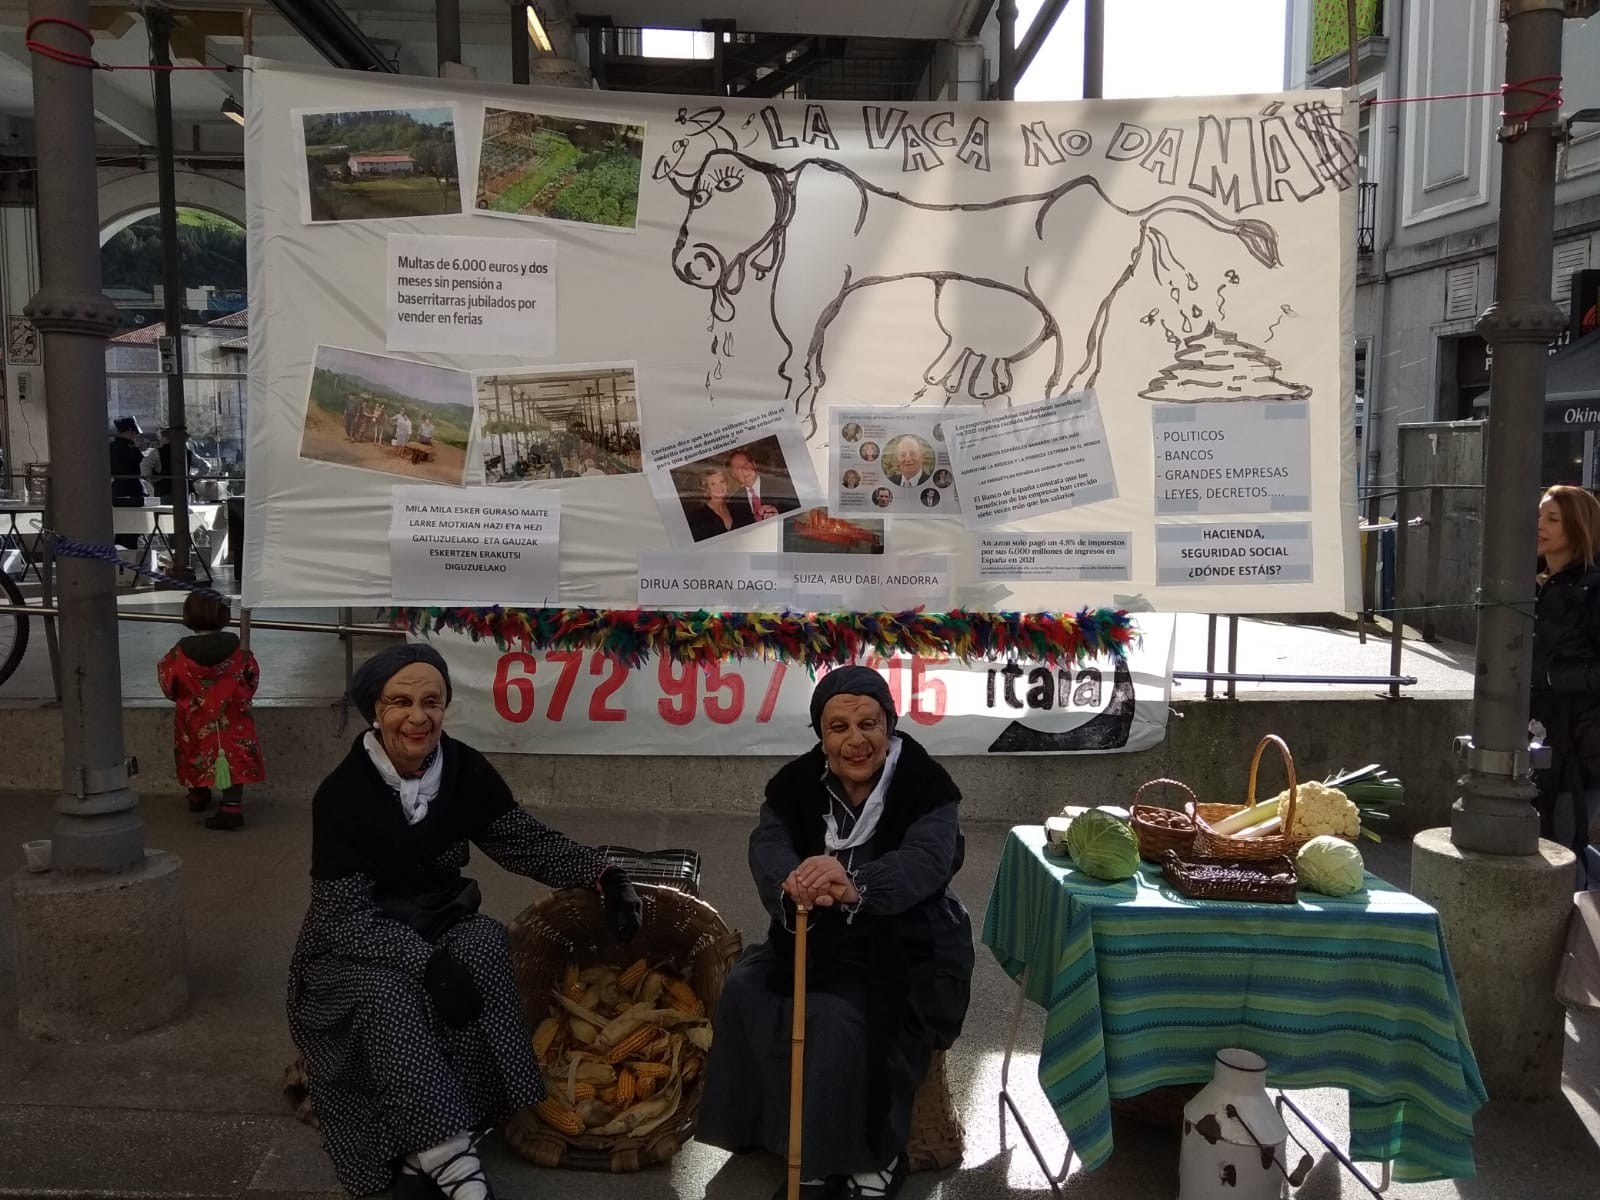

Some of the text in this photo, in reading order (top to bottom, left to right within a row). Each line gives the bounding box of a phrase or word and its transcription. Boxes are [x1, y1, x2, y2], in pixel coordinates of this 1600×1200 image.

[760, 104, 840, 150] LA
[862, 105, 991, 172] VACA
[1105, 122, 1184, 185] DA
[398, 256, 548, 276] Multas de 6.000 euros y dos
[398, 276, 502, 291] meses sin pensión a
[398, 292, 536, 311] baserritarras jubilados por
[398, 311, 483, 325] vender en ferias
[691, 435, 702, 443] que
[1164, 430, 1224, 442] POLITICOS
[1165, 450, 1214, 461] BANCOS
[657, 461, 670, 470] para
[672, 457, 682, 465] que
[1165, 467, 1288, 480] GRANDES EMPRESAS
[982, 491, 1001, 501] Banco
[1013, 483, 1035, 495] España
[1037, 477, 1064, 488] constata
[1065, 475, 1077, 483] que
[1079, 471, 1088, 479] los
[976, 498, 1007, 510] beneficios
[1029, 488, 1059, 499] empresas
[1074, 478, 1097, 488] crecido
[1165, 489, 1202, 500] LEYES,
[978, 510, 992, 518] siete
[1027, 500, 1039, 508] que
[1051, 491, 1075, 501] salarios
[405, 505, 548, 517] MILA MILA ESKER GURASO MAITE
[409, 520, 542, 531] LARRE MOTXIAN HAZI ETA HEZI
[412, 534, 538, 546] GAITUZUELAKO ETA GAUZAK
[1204, 529, 1265, 540] HACIENDA,
[1029, 538, 1046, 548] pagó
[1088, 539, 1125, 548] impuestos
[430, 549, 520, 559] ESKERTZEN ERAKUTSI
[1075, 548, 1104, 556] ingresos
[1181, 546, 1288, 559] SEGURIDAD SOCIAL
[981, 556, 1006, 565] España
[445, 563, 506, 572] DIGUZUELAKO
[1188, 564, 1281, 578] ¿DÓNDE ESTÁIS?
[640, 578, 777, 591] DIRUA SOBRAN DAGO:
[794, 574, 939, 586] SUIZA, ABU DABI, ANDORRA
[493, 650, 629, 723] 672
